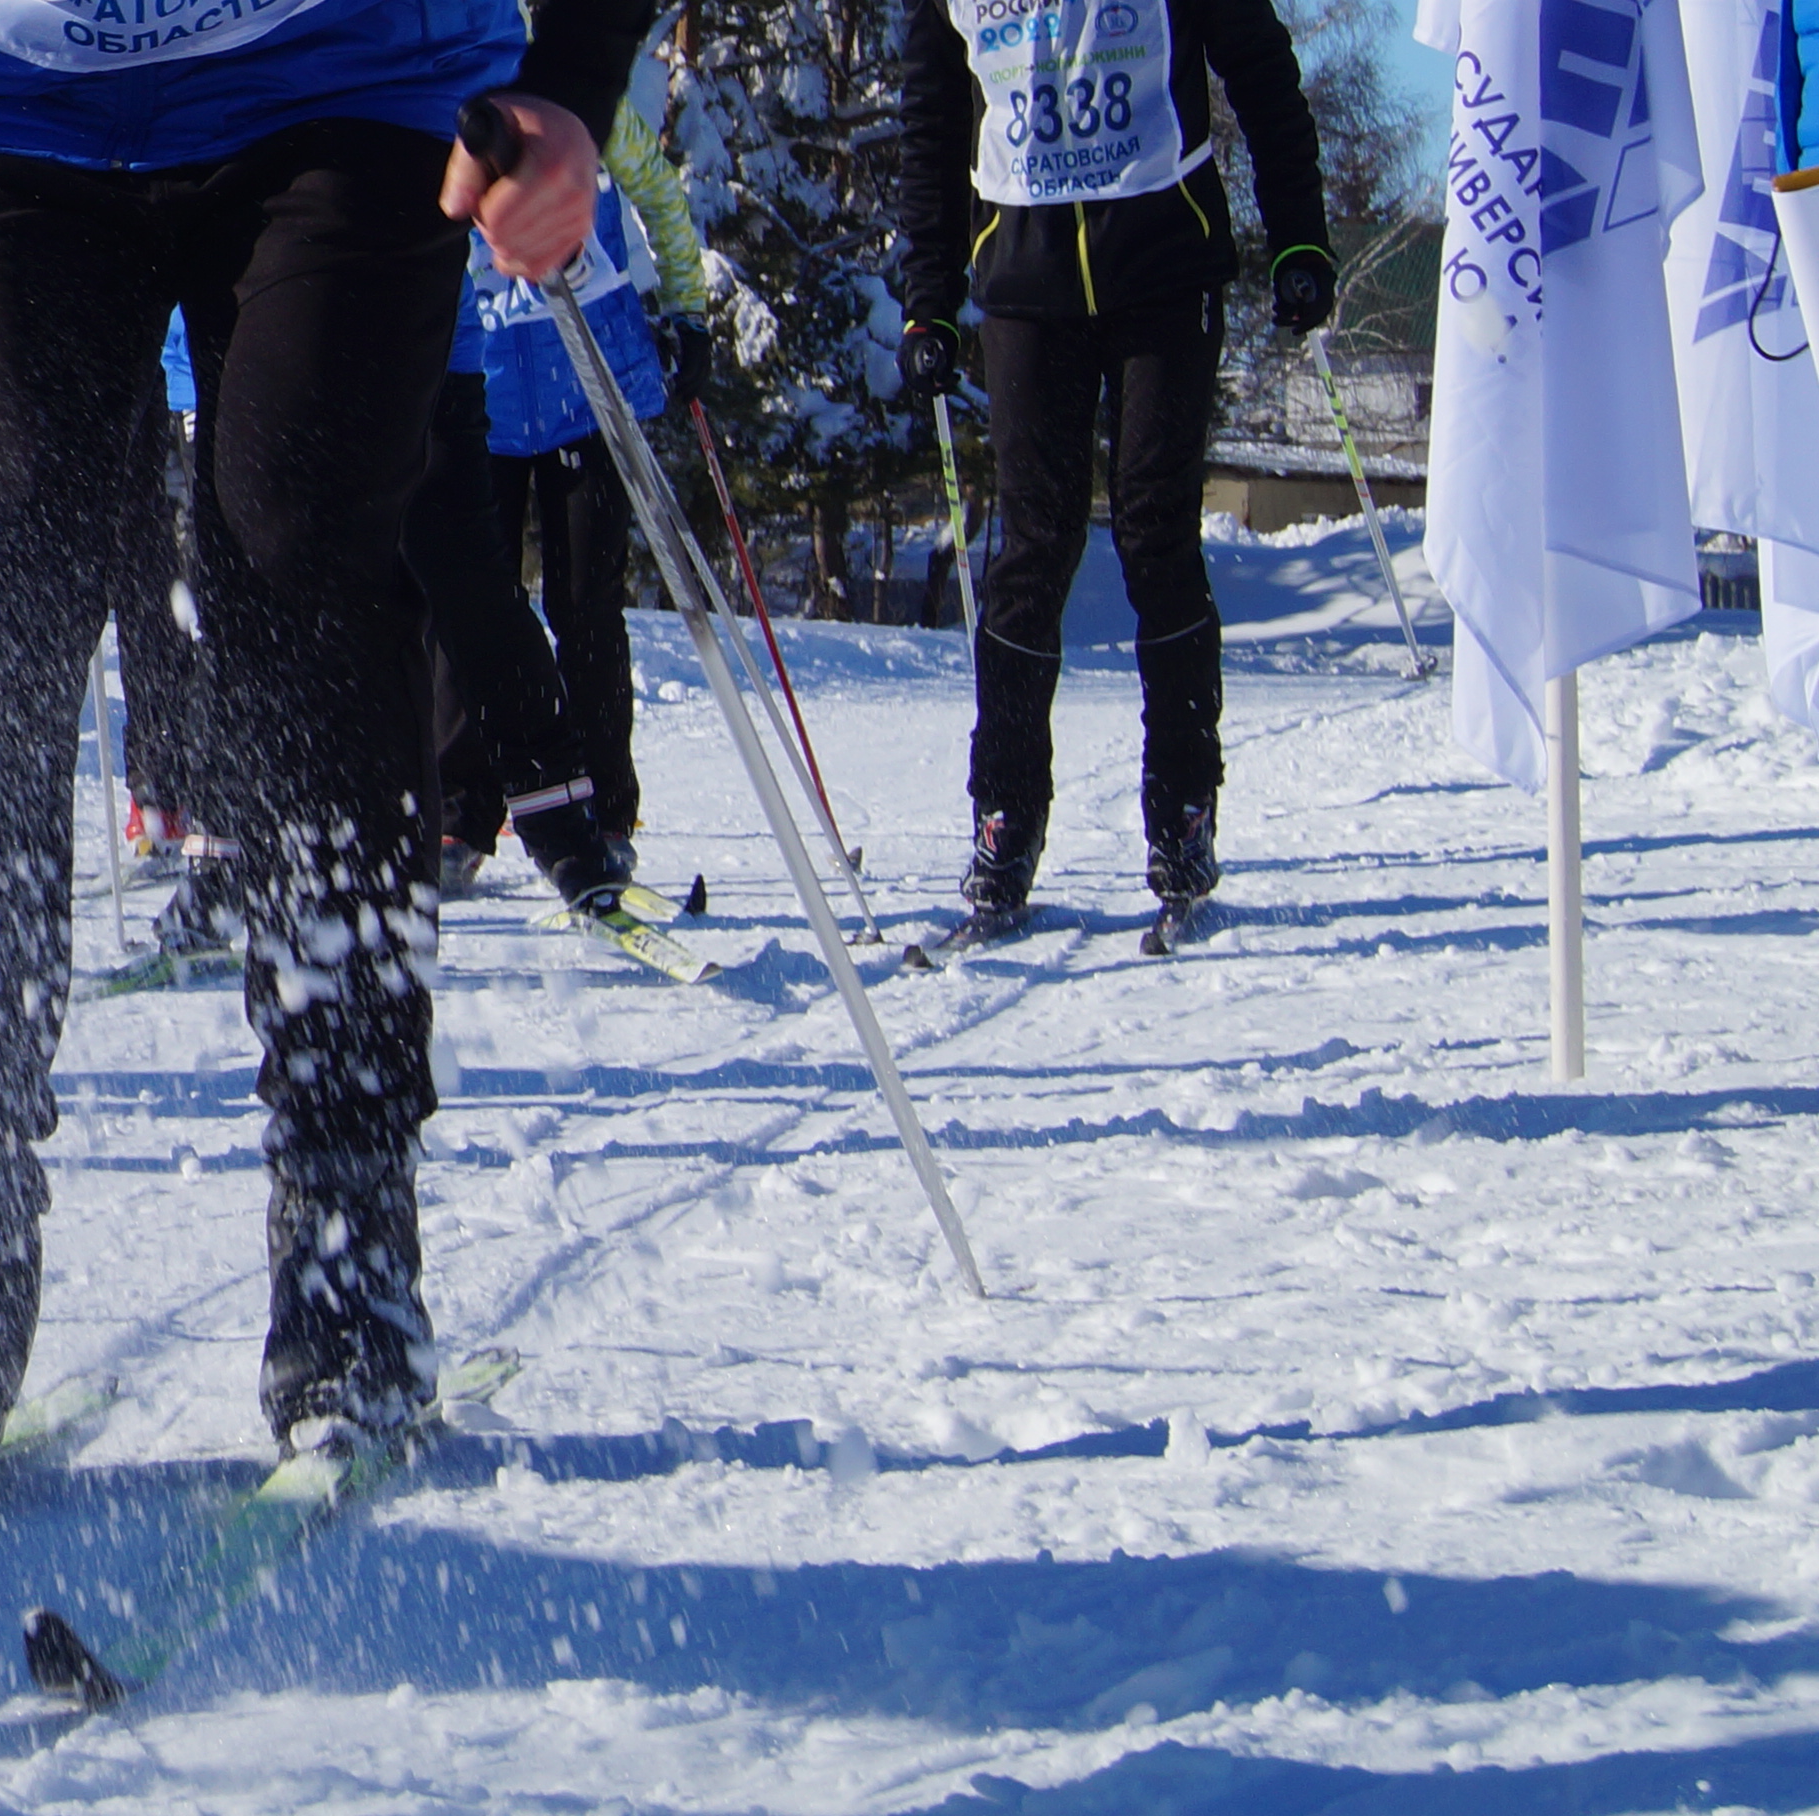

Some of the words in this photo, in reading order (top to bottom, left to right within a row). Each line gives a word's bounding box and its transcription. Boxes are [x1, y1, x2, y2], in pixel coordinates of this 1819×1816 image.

[979, 12, 1061, 53] 2022
[1006, 71, 1132, 148] 8338
[1029, 169, 1121, 199] ОБЛАСТЬ
